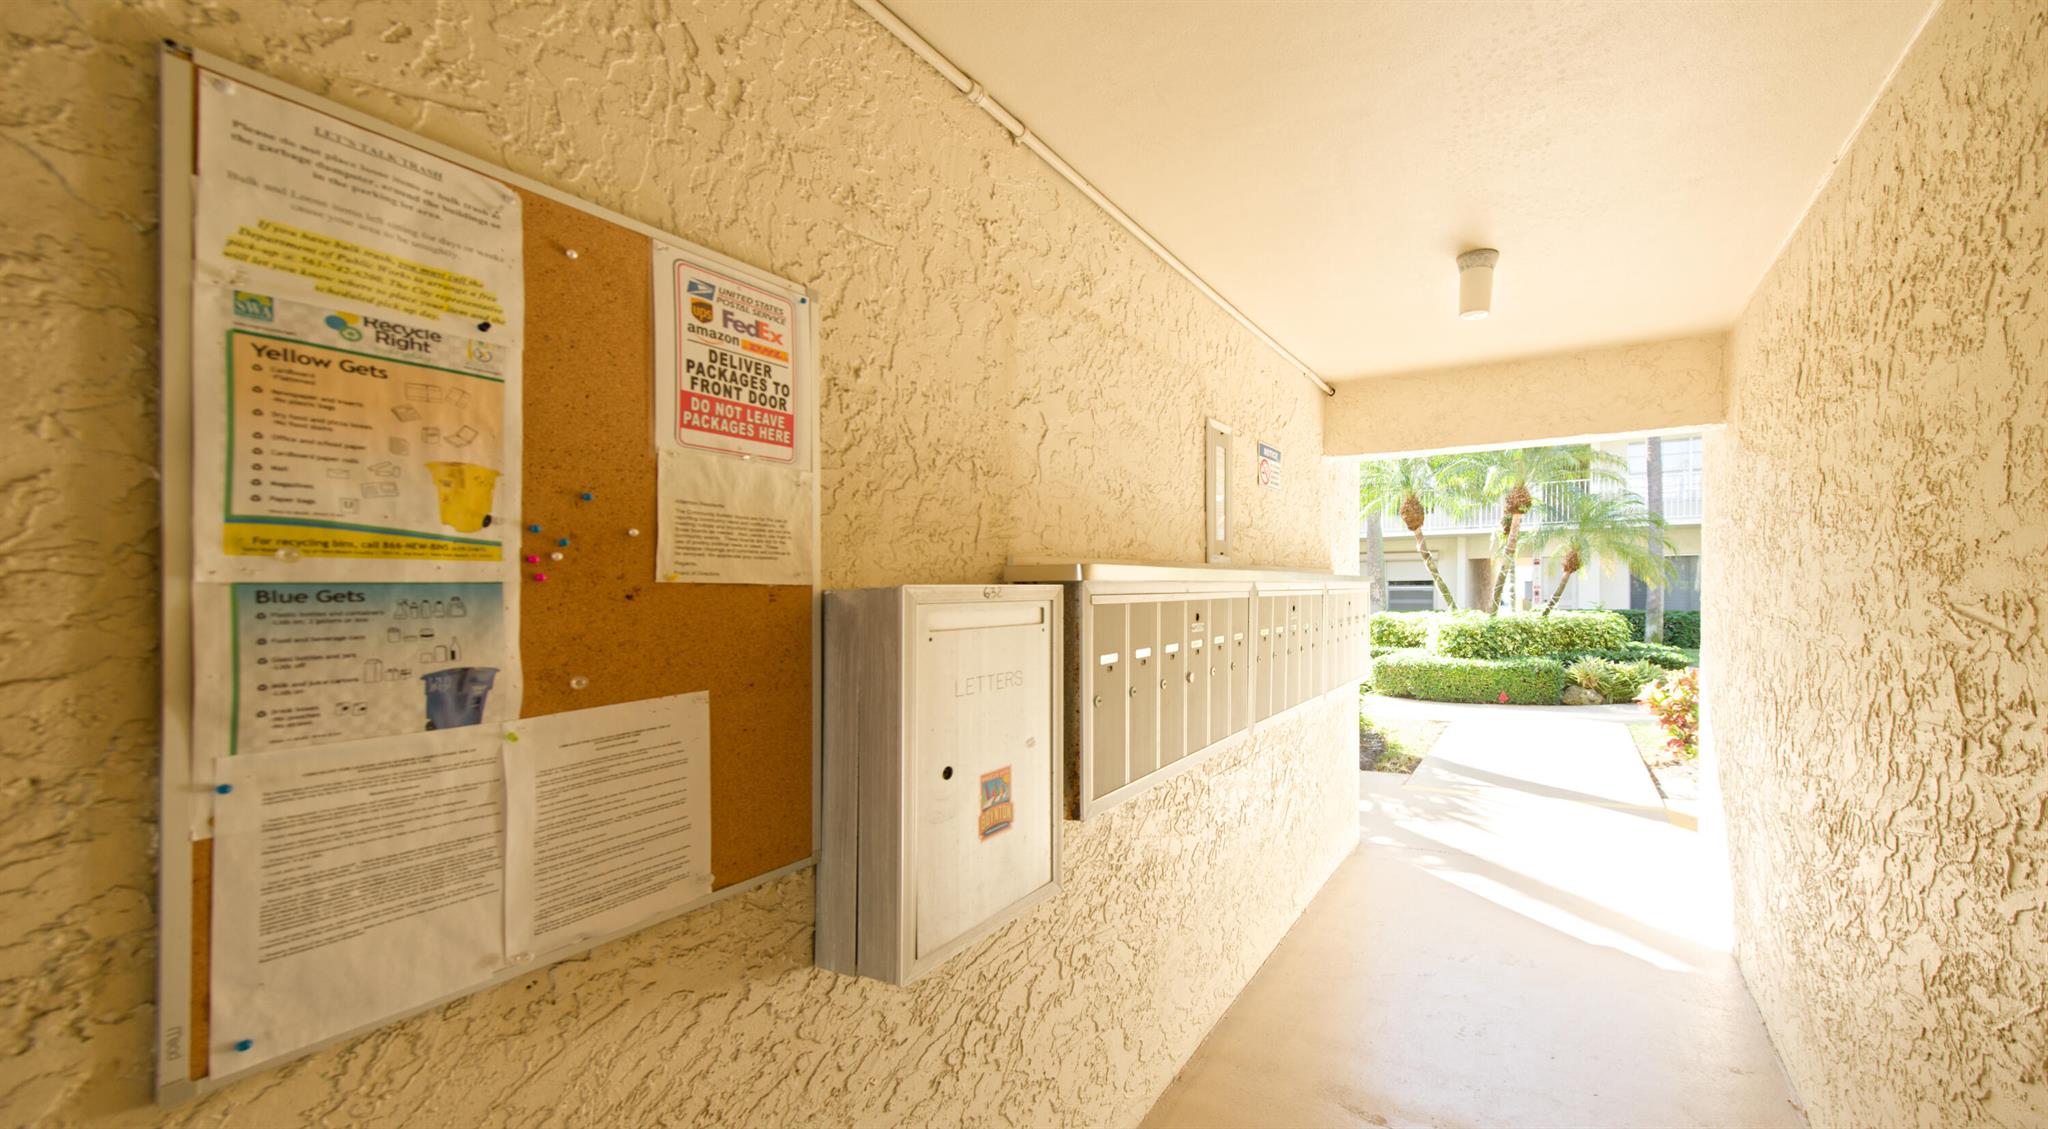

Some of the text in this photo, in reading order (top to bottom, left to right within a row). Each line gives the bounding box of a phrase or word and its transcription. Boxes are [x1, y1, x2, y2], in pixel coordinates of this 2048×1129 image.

[314, 126, 444, 182] LET'S TALK TRASH
[692, 304, 713, 322] ups
[717, 297, 786, 326] POSTAL SERVICE
[718, 286, 785, 315] UNITED STATES
[363, 316, 442, 342] Recycle
[375, 330, 432, 353] Right
[687, 323, 740, 347] amazon
[722, 308, 784, 346] FedEx
[250, 341, 389, 380] Yellow Gets
[708, 349, 772, 379] DELIVER
[686, 359, 790, 397] PACKAGES TO
[690, 377, 787, 411] FRONT DOOR
[690, 397, 785, 428] DO NOT LEAVE
[683, 411, 791, 444] PACKAGES HERE
[252, 535, 272, 547] For
[275, 537, 330, 550] recycling
[331, 539, 358, 550] bins,
[360, 540, 380, 550] call
[255, 589, 366, 605] Blue Gets
[954, 669, 1024, 698] LETTERS
